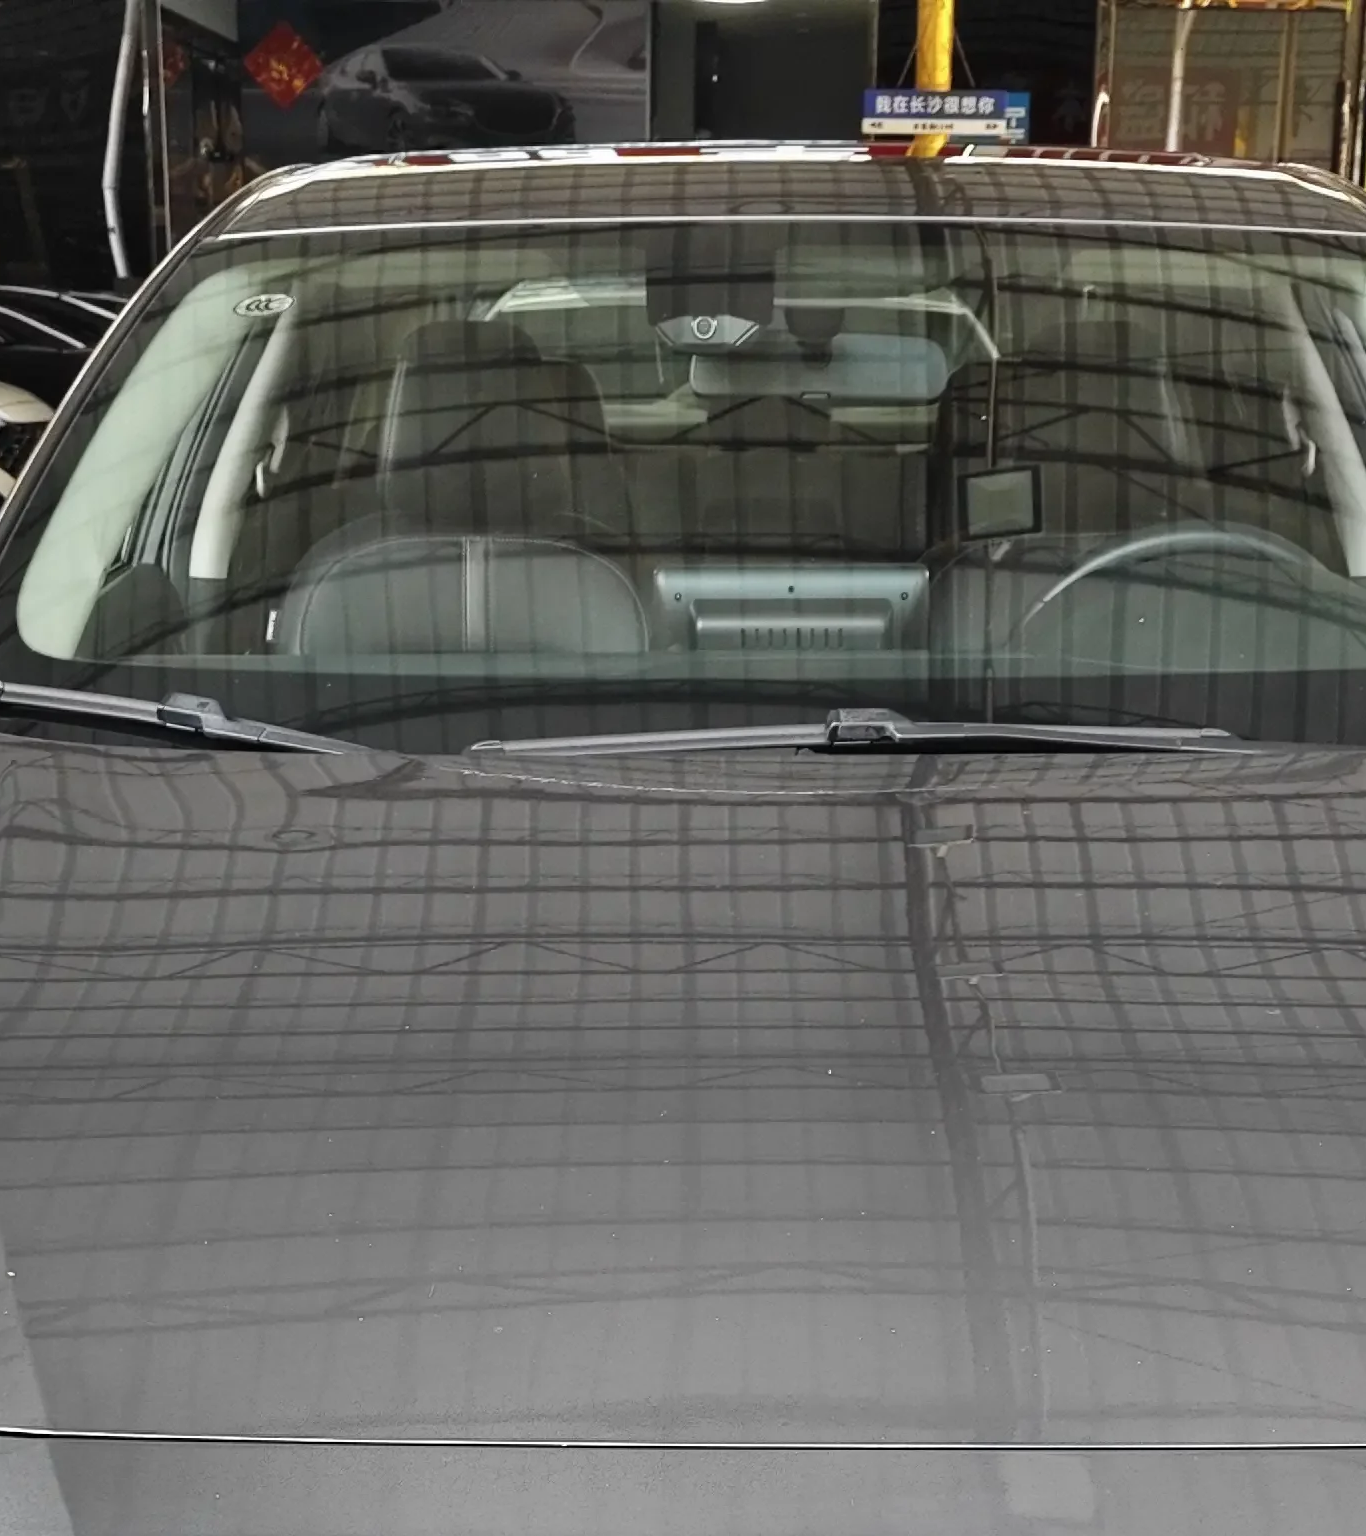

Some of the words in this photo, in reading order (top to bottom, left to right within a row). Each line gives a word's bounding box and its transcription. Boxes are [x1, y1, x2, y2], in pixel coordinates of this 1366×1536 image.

[875, 95, 996, 116] 我在长沙很想你
